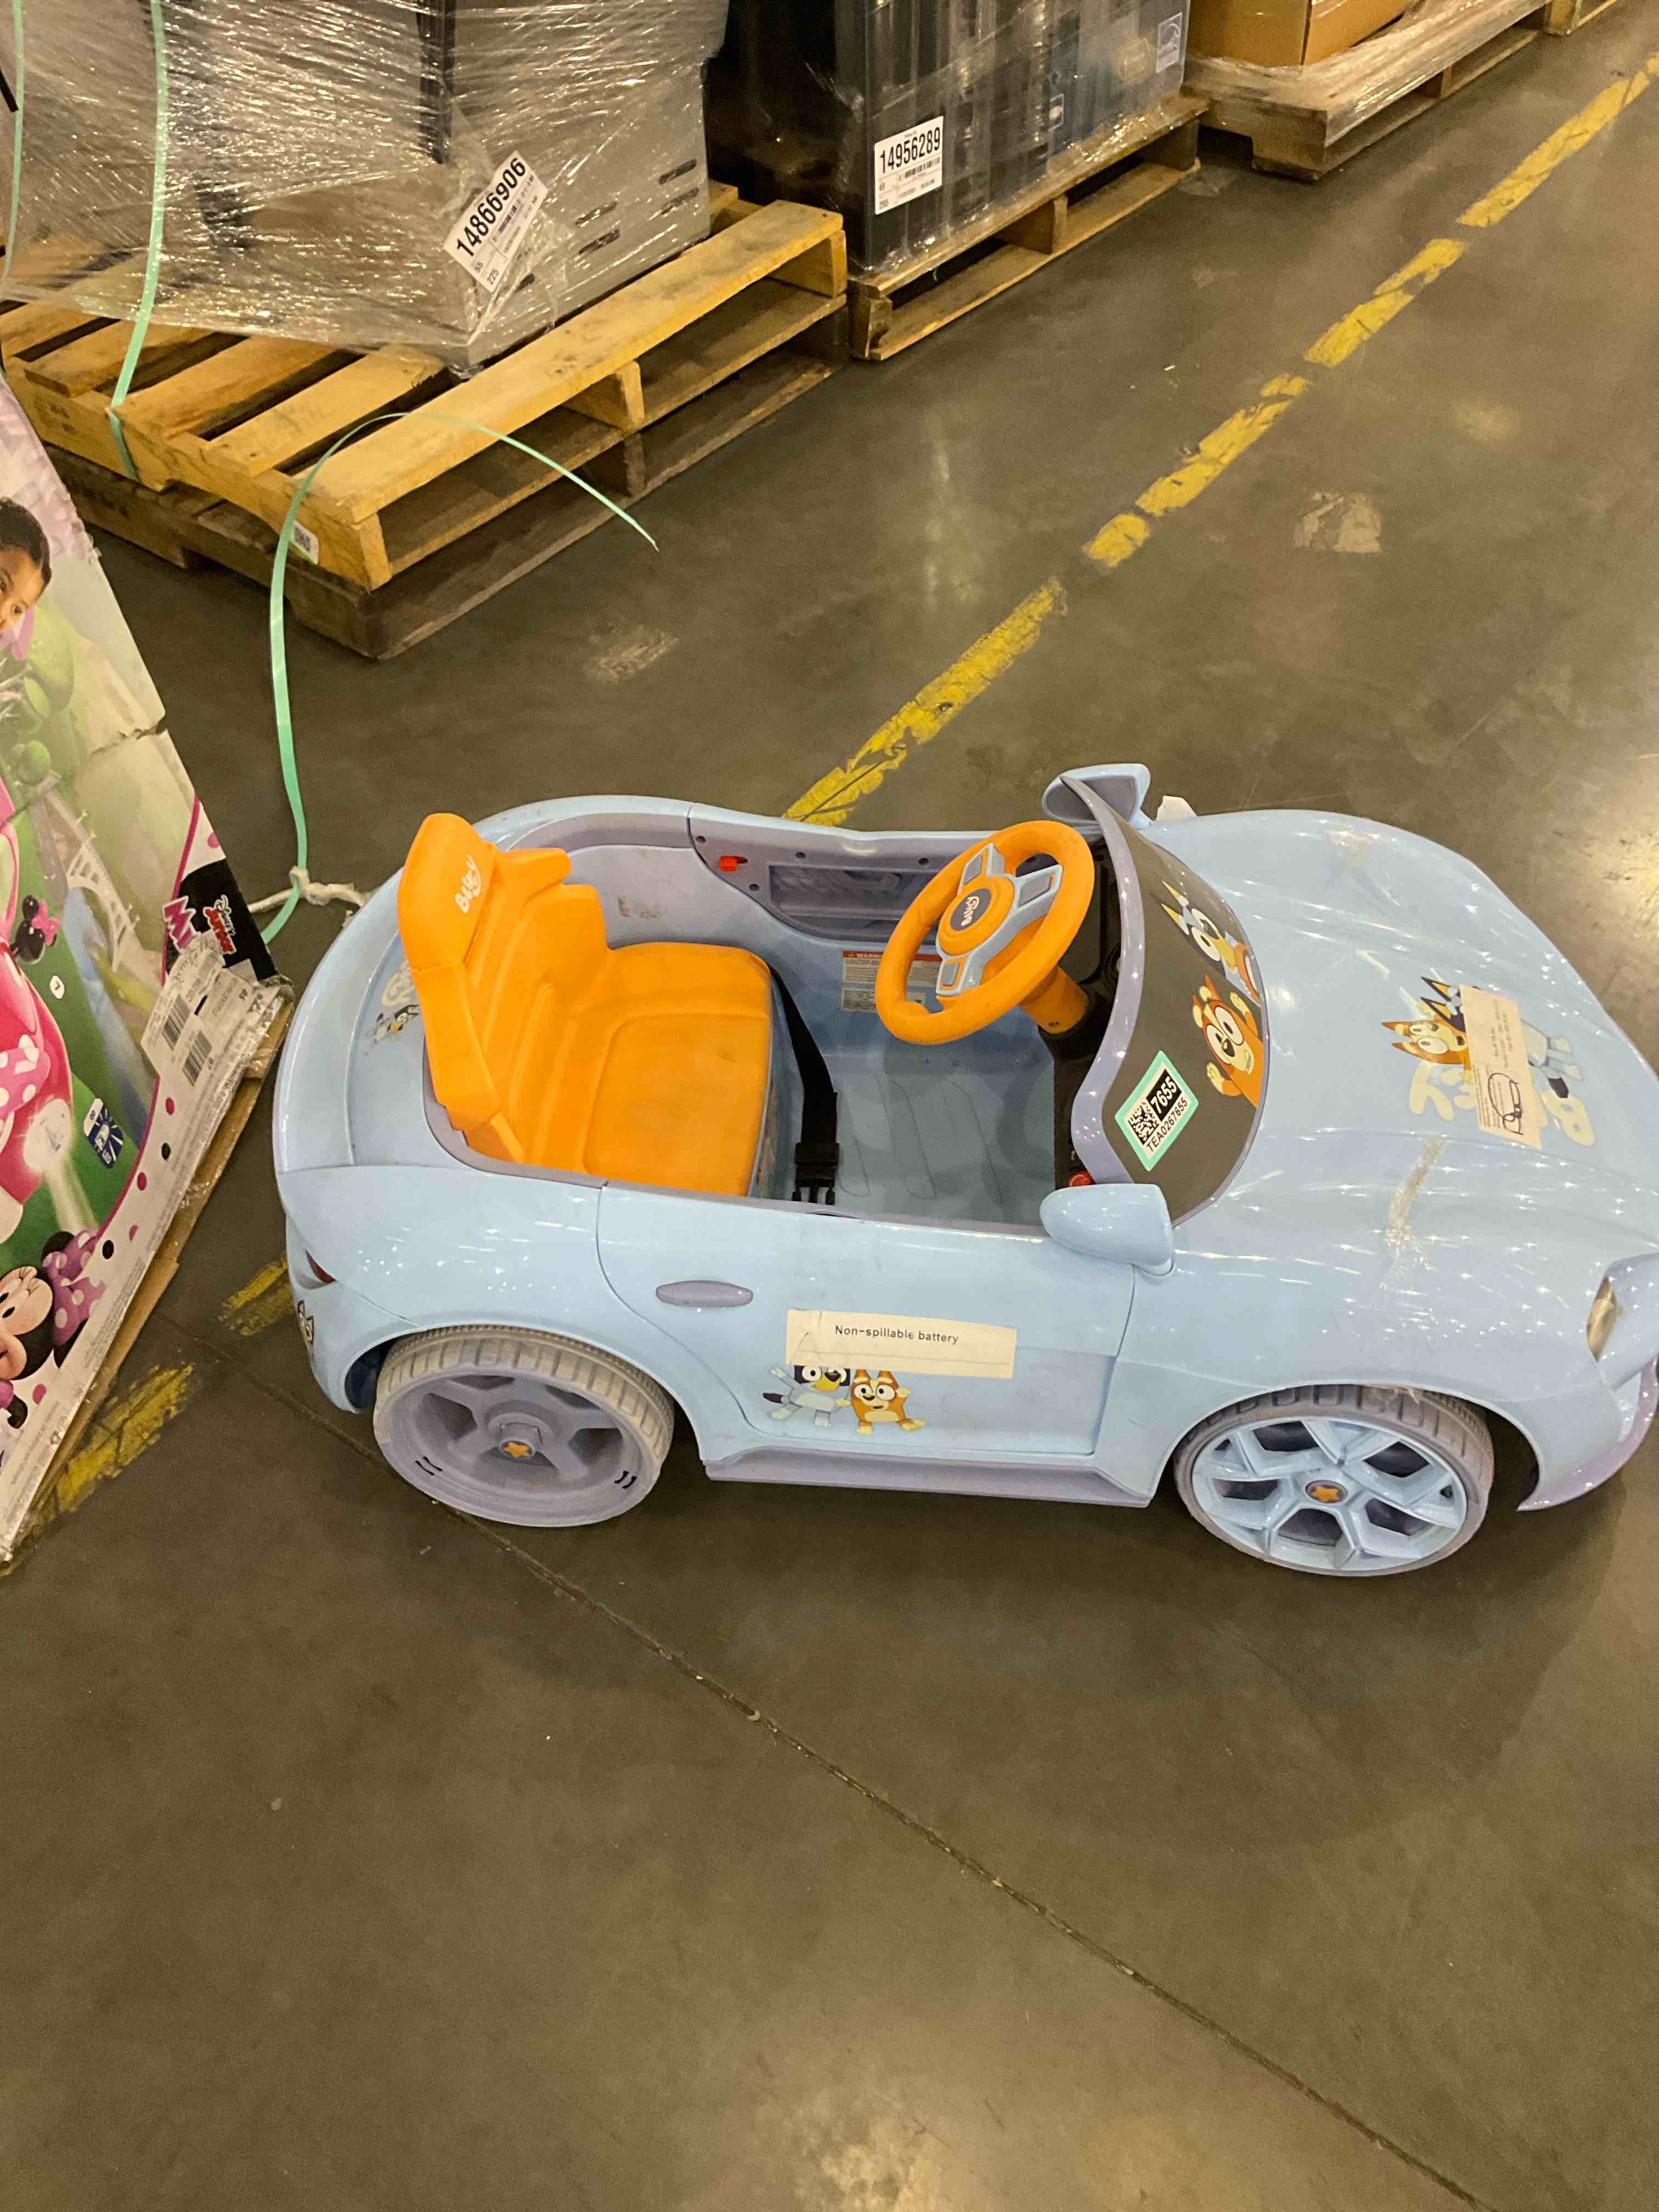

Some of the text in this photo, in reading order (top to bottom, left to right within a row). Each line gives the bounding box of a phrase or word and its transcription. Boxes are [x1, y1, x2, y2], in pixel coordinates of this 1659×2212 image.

[880, 127, 940, 174] 14956289
[456, 157, 526, 257] 14866906
[1150, 1076, 1179, 1115] 7655
[1146, 1098, 1188, 1153] TEA0267655
[835, 1325, 958, 1345] Non-spillable battery
